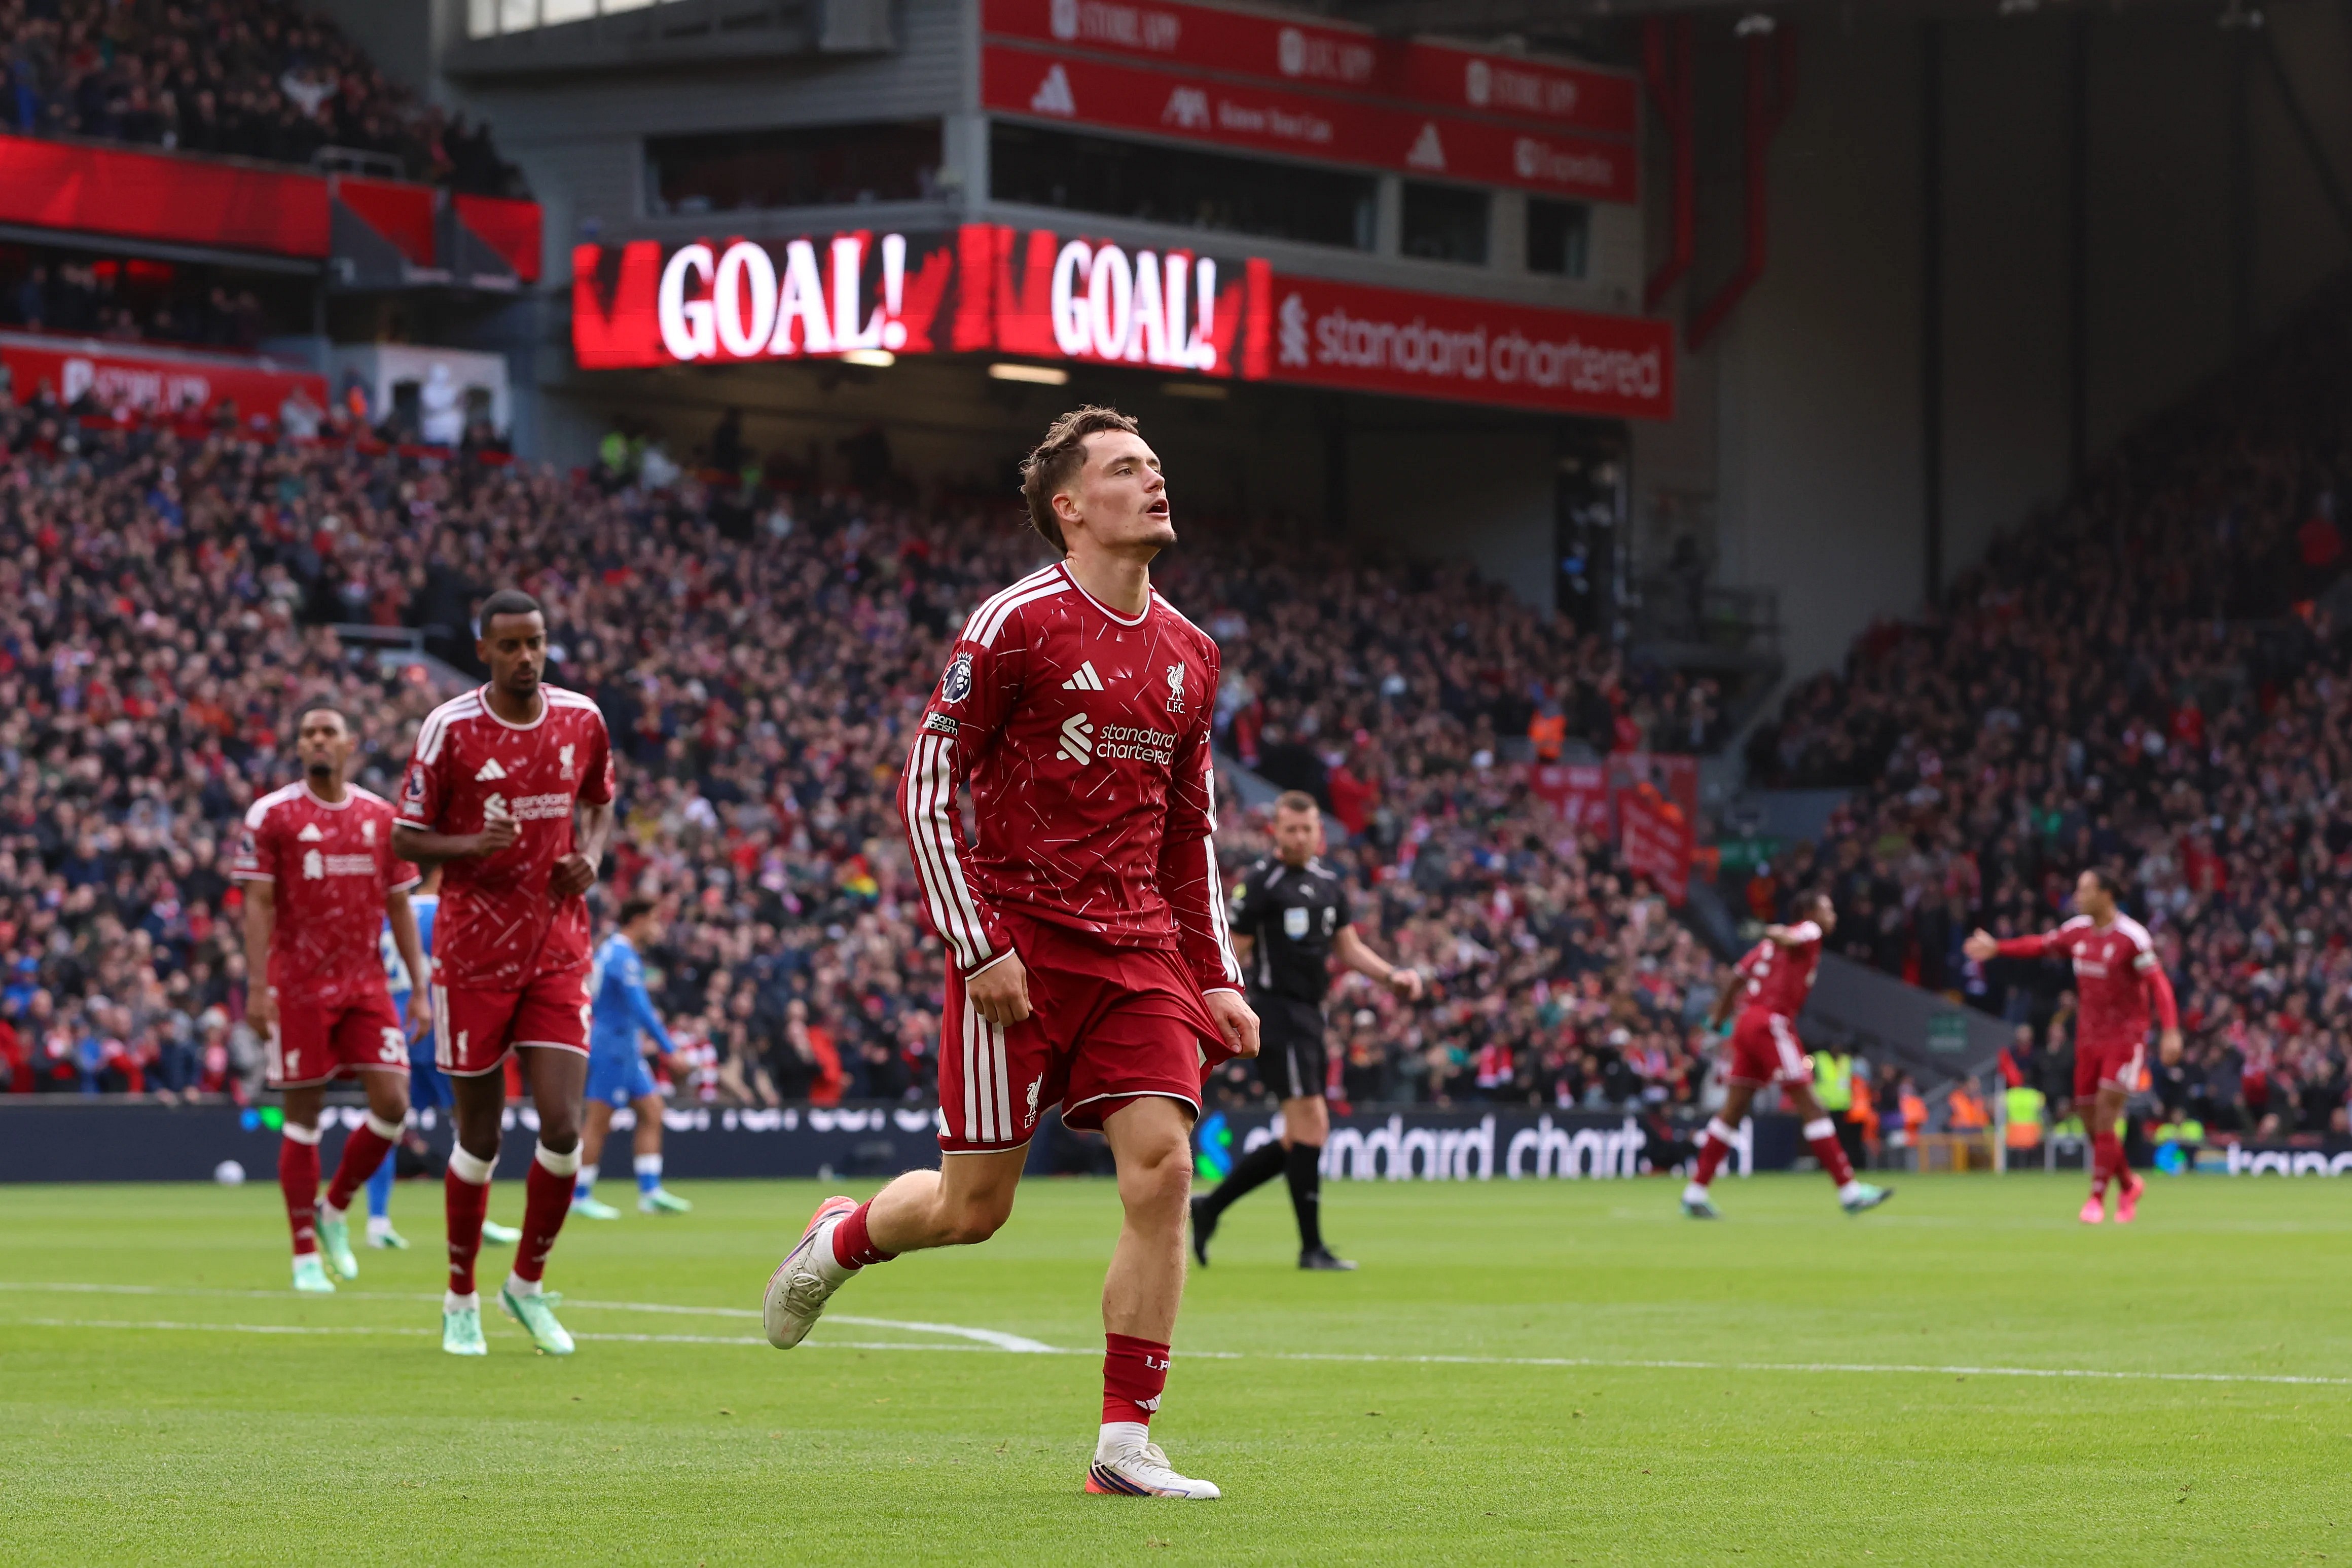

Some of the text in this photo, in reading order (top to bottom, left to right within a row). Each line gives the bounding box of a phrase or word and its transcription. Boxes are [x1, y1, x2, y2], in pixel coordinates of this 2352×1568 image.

[659, 233, 908, 360] GOAL!
[1051, 239, 1216, 371] GOAL!
[1316, 307, 1660, 398] standard chartered
[1096, 740, 1174, 765] chartered
[1100, 723, 1177, 748] standard
[1244, 1112, 1754, 1181] ndard chartd
